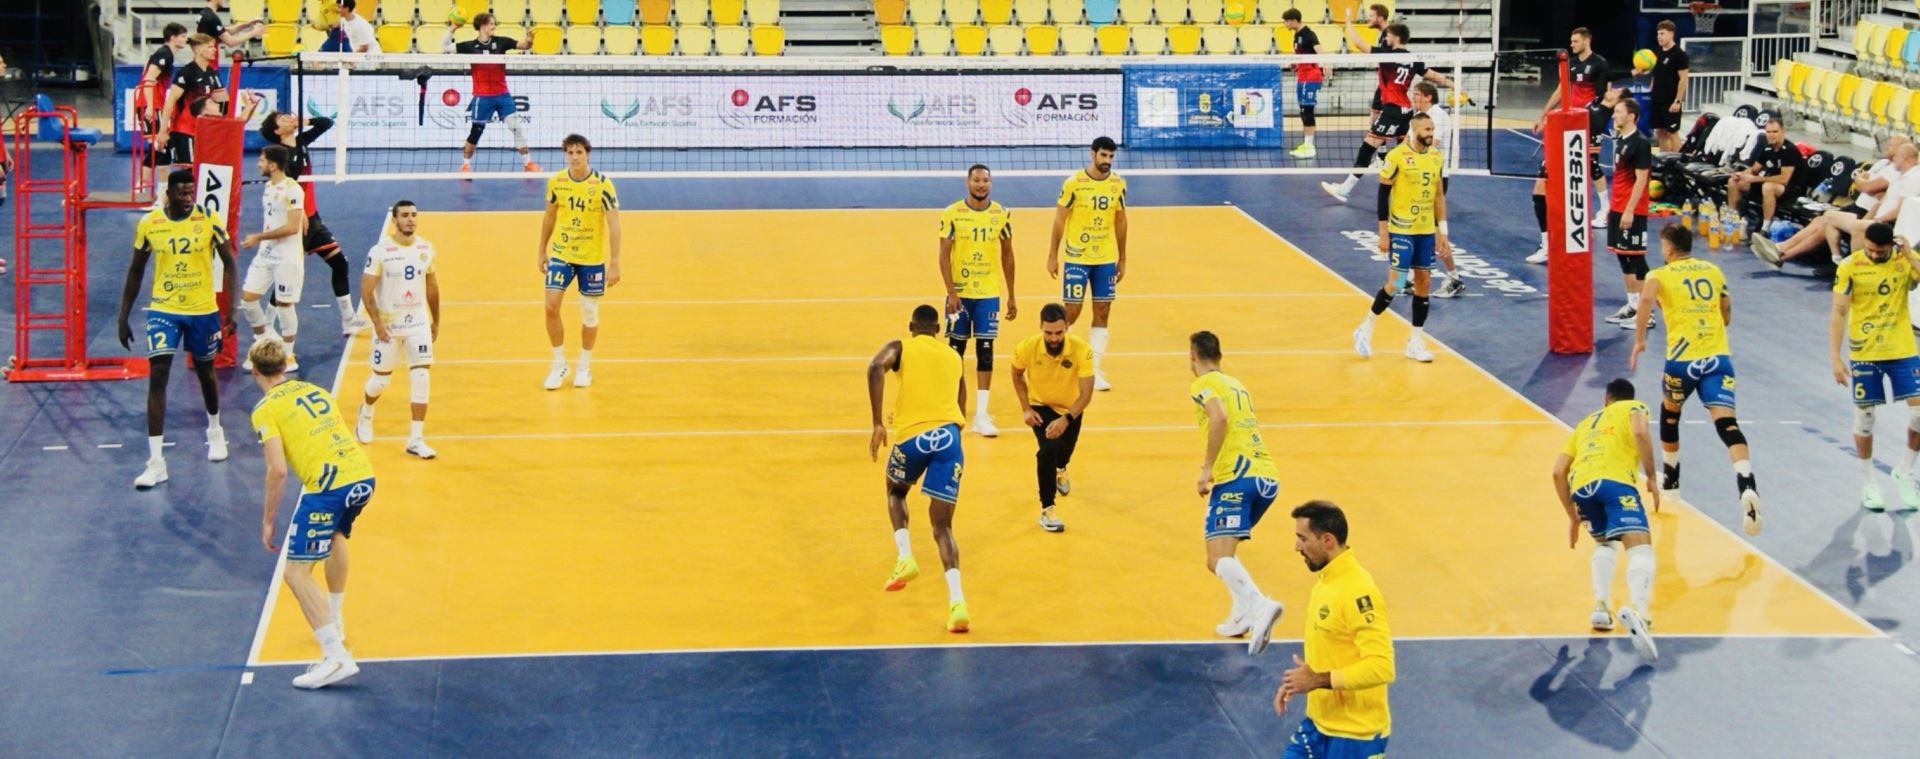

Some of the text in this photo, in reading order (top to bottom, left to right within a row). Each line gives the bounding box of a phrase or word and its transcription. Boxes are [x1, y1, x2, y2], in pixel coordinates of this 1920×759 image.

[1394, 67, 1410, 85] 21
[350, 96, 404, 115] AFS
[642, 96, 693, 115] AFS
[754, 95, 816, 112] AFS
[1037, 93, 1098, 110] AFS
[754, 113, 817, 124] FORMACIÓN
[1036, 112, 1099, 122] FORMACIÓN
[1422, 172, 1431, 186] 5
[568, 196, 586, 212] 14
[1091, 195, 1109, 210] 18
[972, 227, 986, 242] 11
[168, 237, 192, 255] 12
[1391, 252, 1400, 267] 5
[404, 265, 415, 280] 8
[546, 270, 565, 286] 14
[1065, 283, 1084, 298] 18
[1683, 278, 1714, 301] 10
[1877, 279, 1891, 296] 6
[147, 331, 168, 350] 12
[373, 350, 382, 365] 8
[1854, 383, 1866, 400] 6
[295, 390, 331, 419] 15
